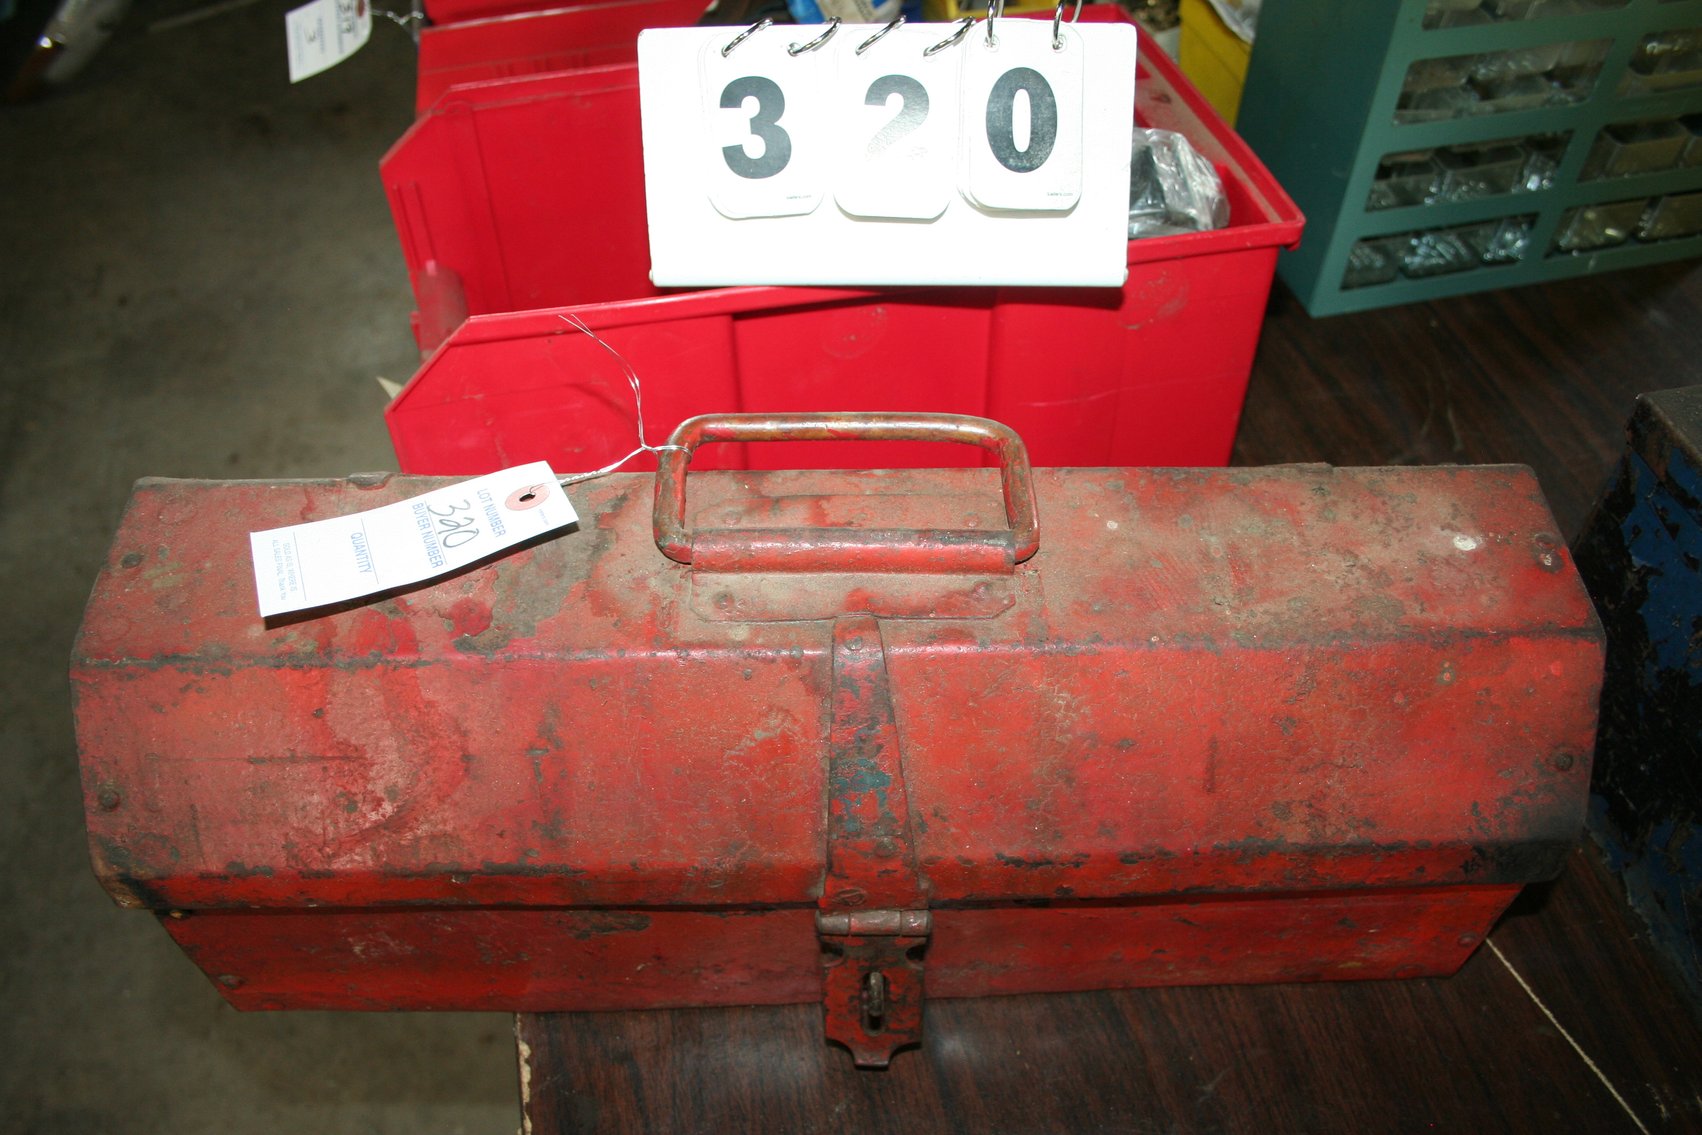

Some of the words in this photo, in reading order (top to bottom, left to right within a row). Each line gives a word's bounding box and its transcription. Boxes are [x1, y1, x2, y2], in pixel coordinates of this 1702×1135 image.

[477, 488, 493, 504] LOT
[412, 502, 430, 530] BUYER
[423, 530, 444, 568] NUMBER
[427, 499, 480, 548] 320
[483, 504, 506, 538] NUMBER
[350, 532, 373, 573] QUANTITY
